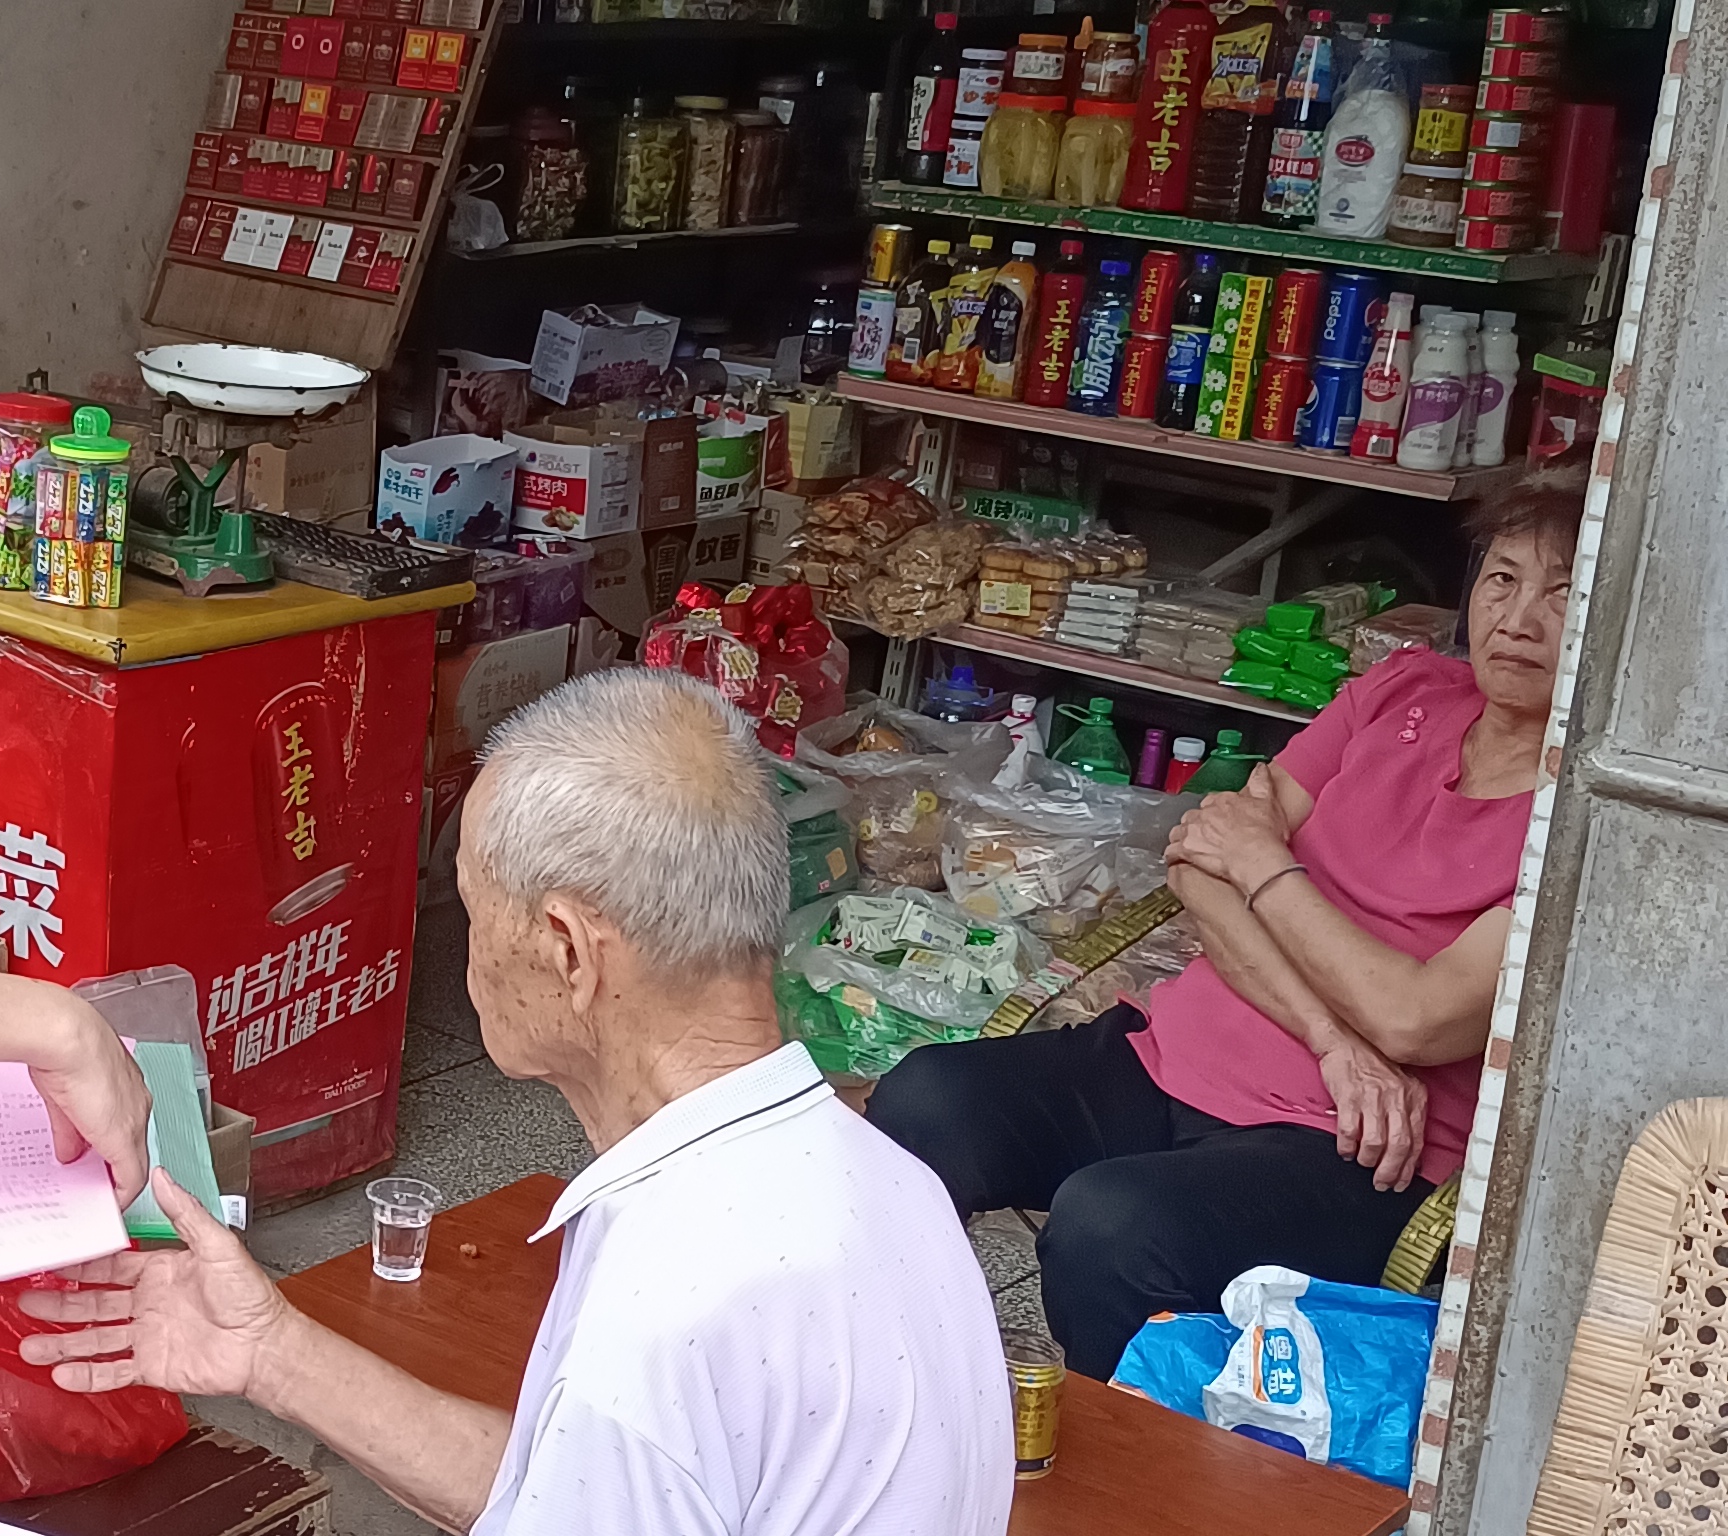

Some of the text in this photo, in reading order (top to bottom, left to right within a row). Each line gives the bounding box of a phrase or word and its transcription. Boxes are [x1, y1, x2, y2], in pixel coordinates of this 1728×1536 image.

[1146, 47, 1192, 176] 王老吉
[1137, 267, 1159, 323] 王老吉
[1276, 283, 1299, 345] 王老吉
[1323, 290, 1343, 341] pepsi
[1038, 299, 1073, 383] 王老吉
[1122, 351, 1141, 408] 王老吉
[1261, 374, 1284, 432] 王老吉
[280, 721, 318, 861] 王老吉
[205, 919, 352, 1039] 过吉祥年
[232, 949, 402, 1075] 喝红罐王老吉
